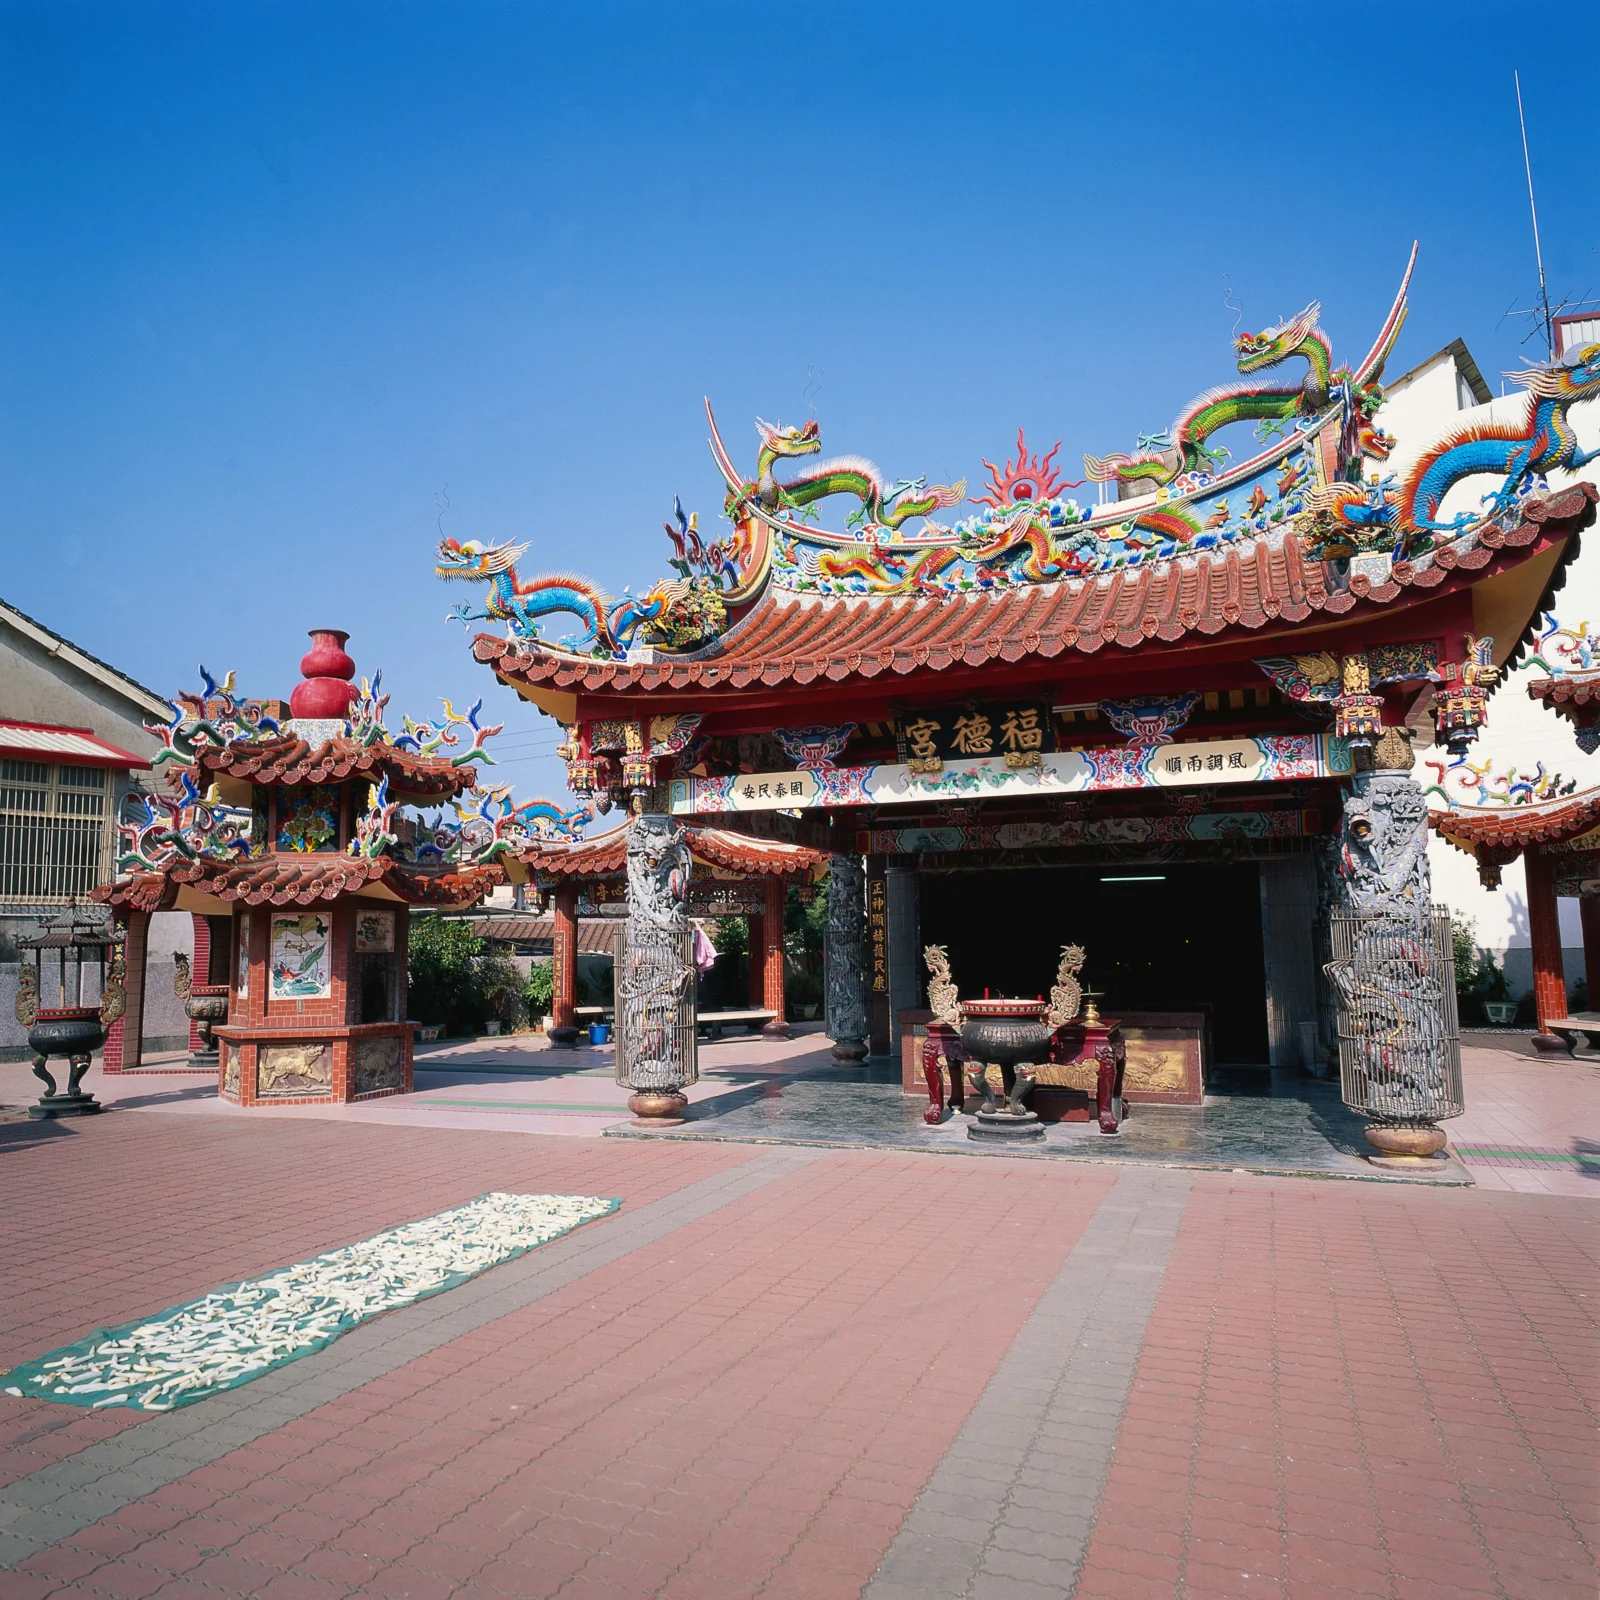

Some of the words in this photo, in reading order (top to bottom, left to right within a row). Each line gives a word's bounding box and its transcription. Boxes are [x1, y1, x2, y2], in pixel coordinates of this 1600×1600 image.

[905, 707, 1043, 758] 福德宮
[1164, 752, 1247, 773] 風調雨順
[742, 781, 803, 800] 國泰民安
